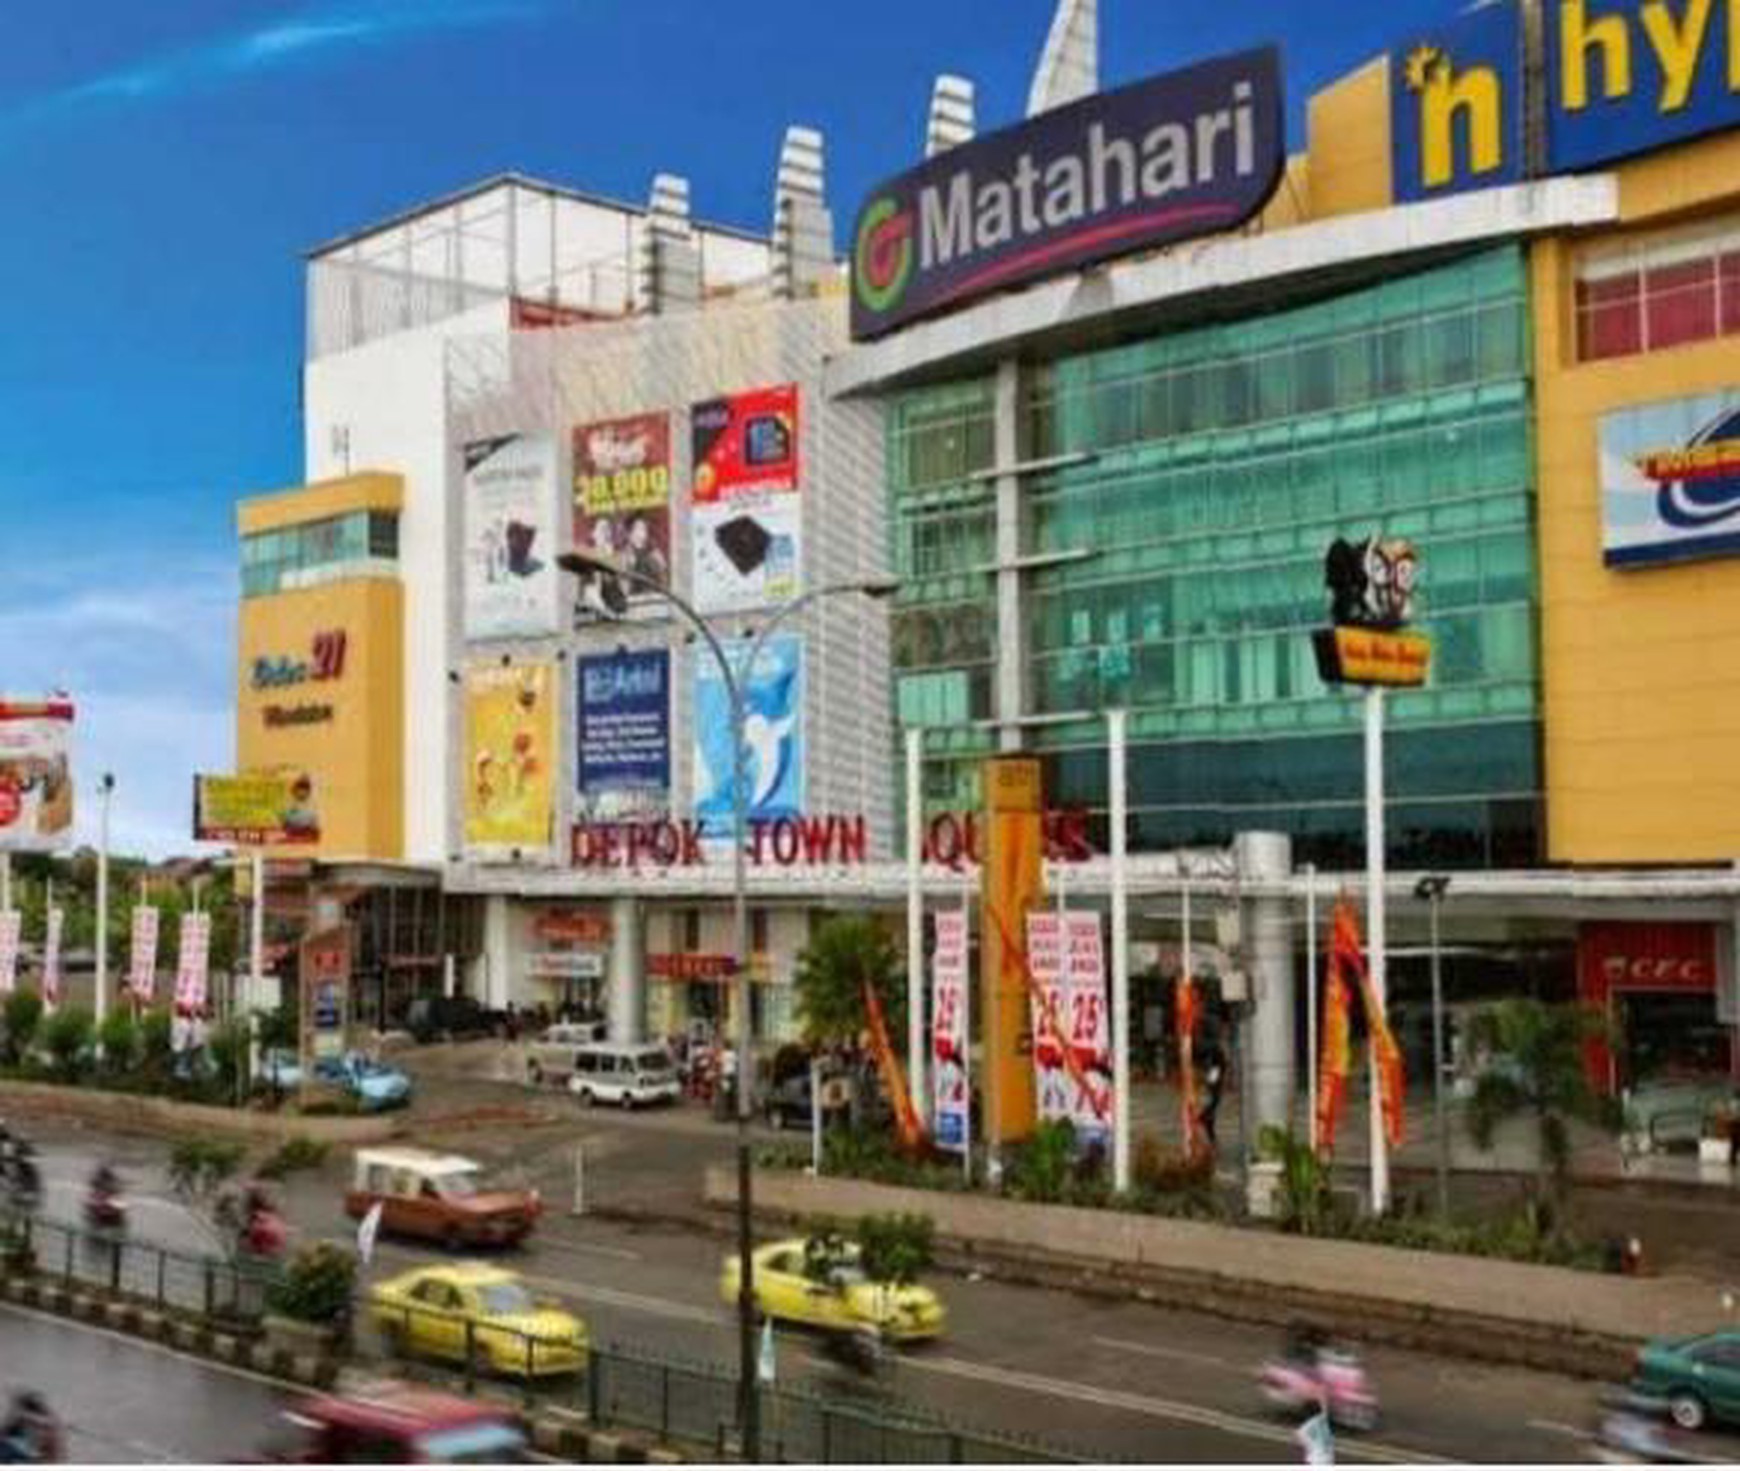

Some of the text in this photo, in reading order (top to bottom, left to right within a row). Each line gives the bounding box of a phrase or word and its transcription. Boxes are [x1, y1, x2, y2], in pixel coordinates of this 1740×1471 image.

[918, 81, 1256, 270] Matahari
[571, 818, 705, 868] DEPOK
[746, 812, 867, 867] TOWN
[1630, 956, 1704, 980] CFC
